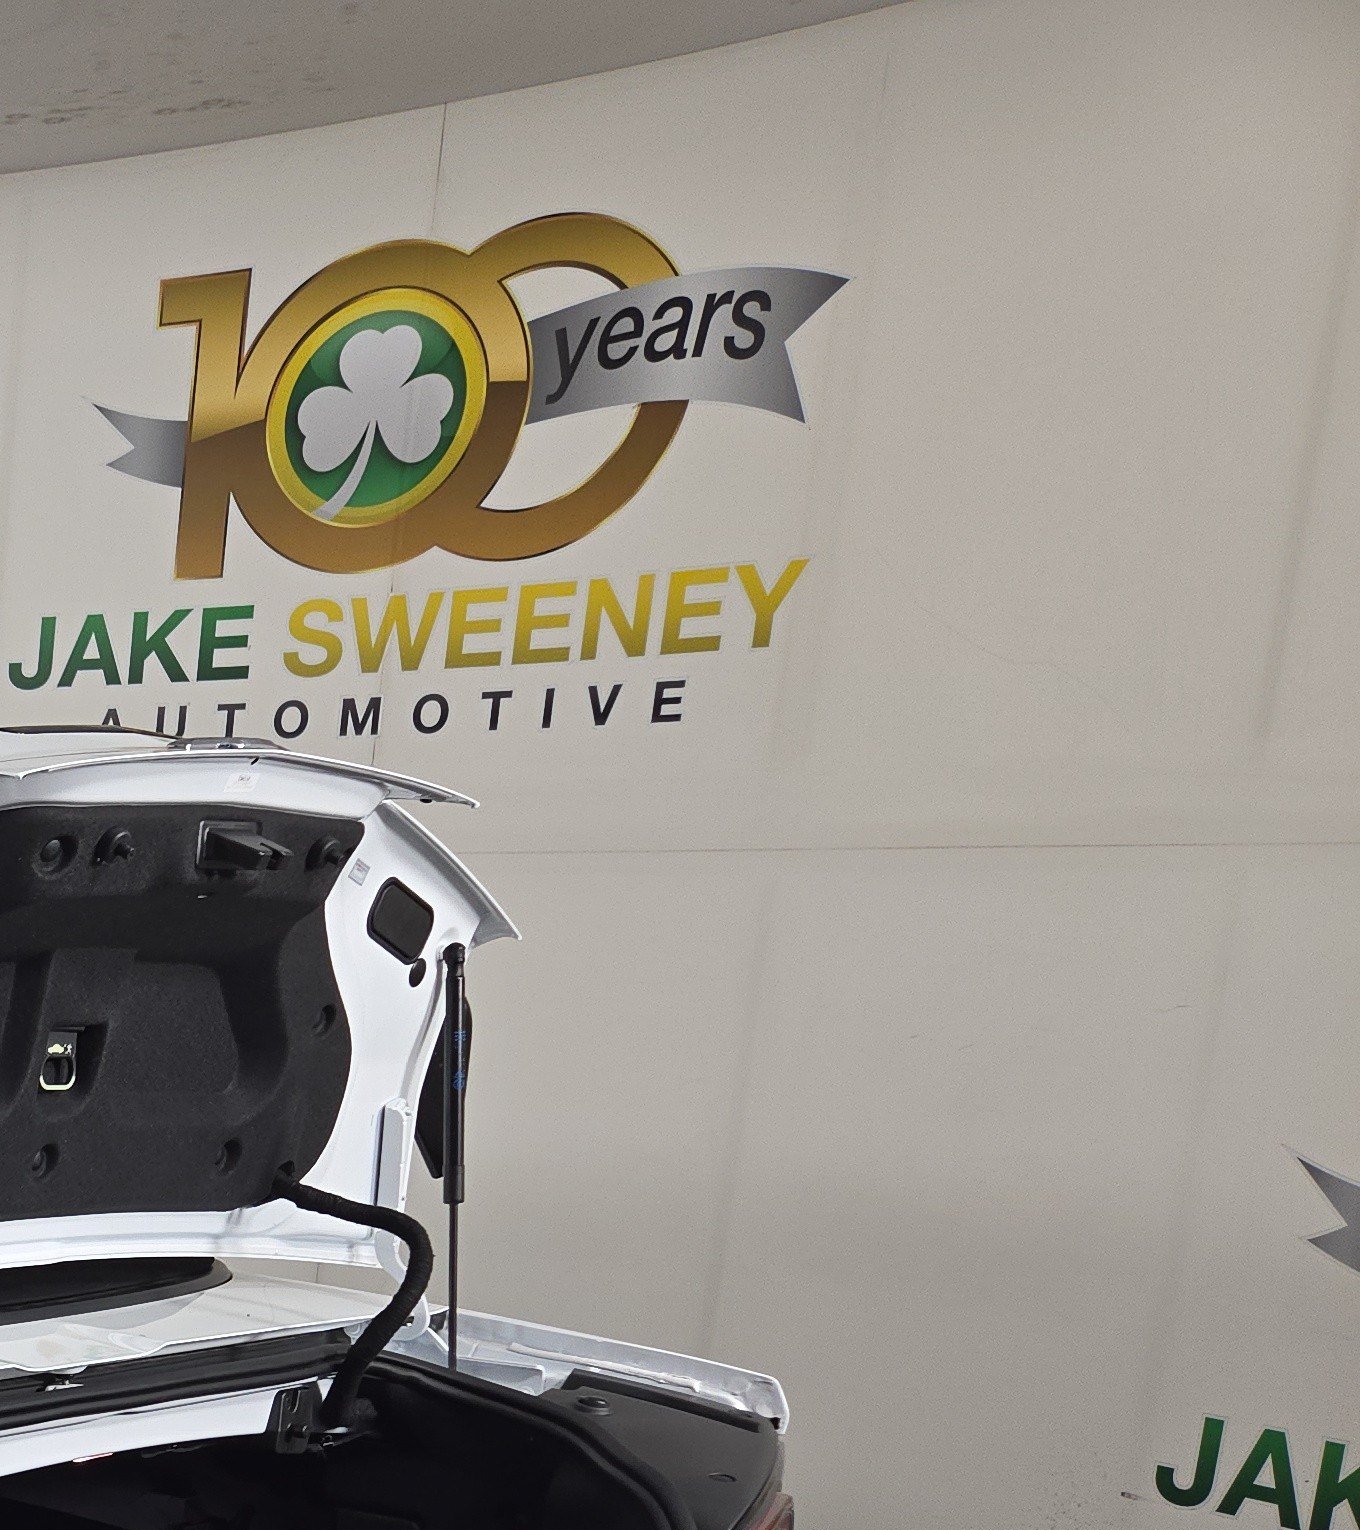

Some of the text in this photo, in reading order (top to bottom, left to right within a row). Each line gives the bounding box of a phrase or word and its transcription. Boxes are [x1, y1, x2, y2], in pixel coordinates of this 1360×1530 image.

[158, 212, 772, 580] 100 years
[7, 558, 812, 692] JAKE SWEENEY
